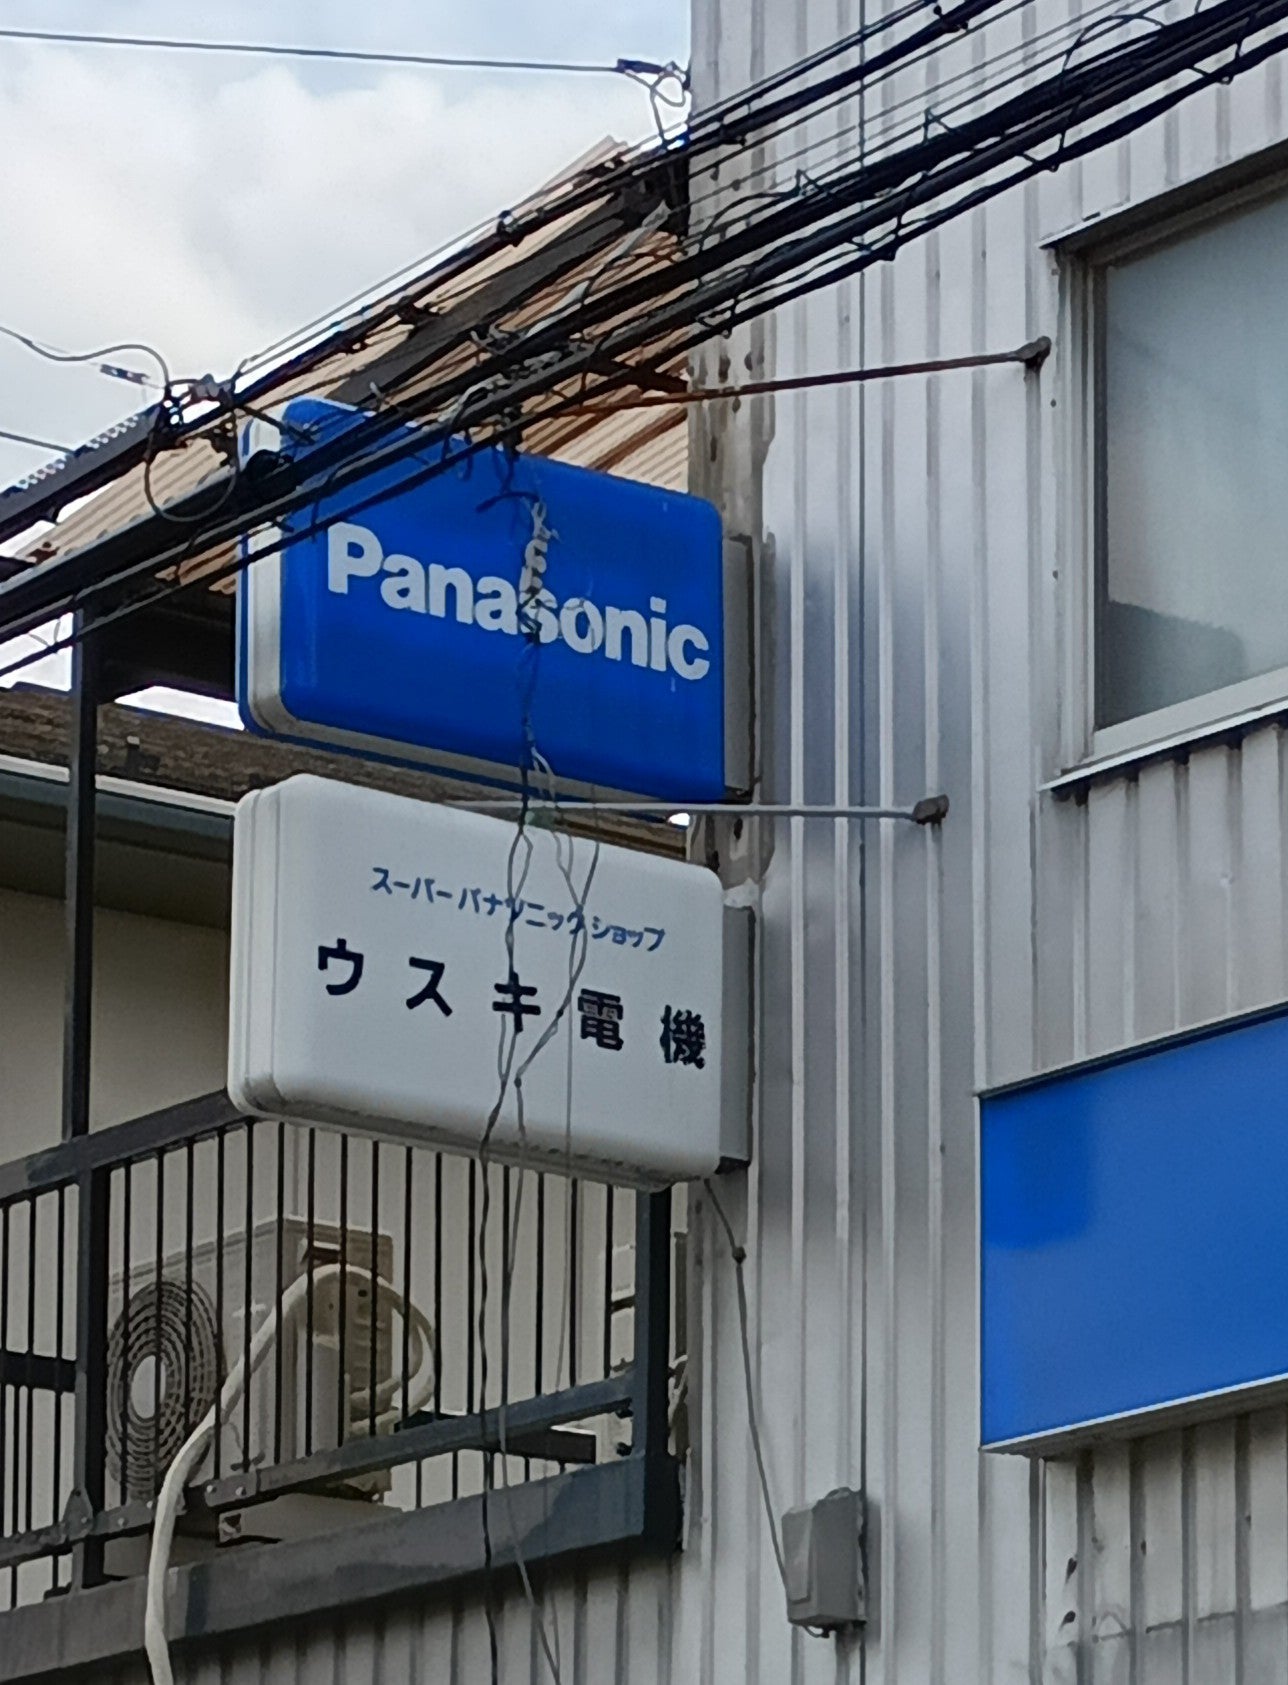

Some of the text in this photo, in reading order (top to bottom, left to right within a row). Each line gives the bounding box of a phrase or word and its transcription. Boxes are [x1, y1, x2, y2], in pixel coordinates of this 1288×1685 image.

[327, 521, 710, 680] Panasonic
[317, 938, 706, 1069] ウスキ電機
